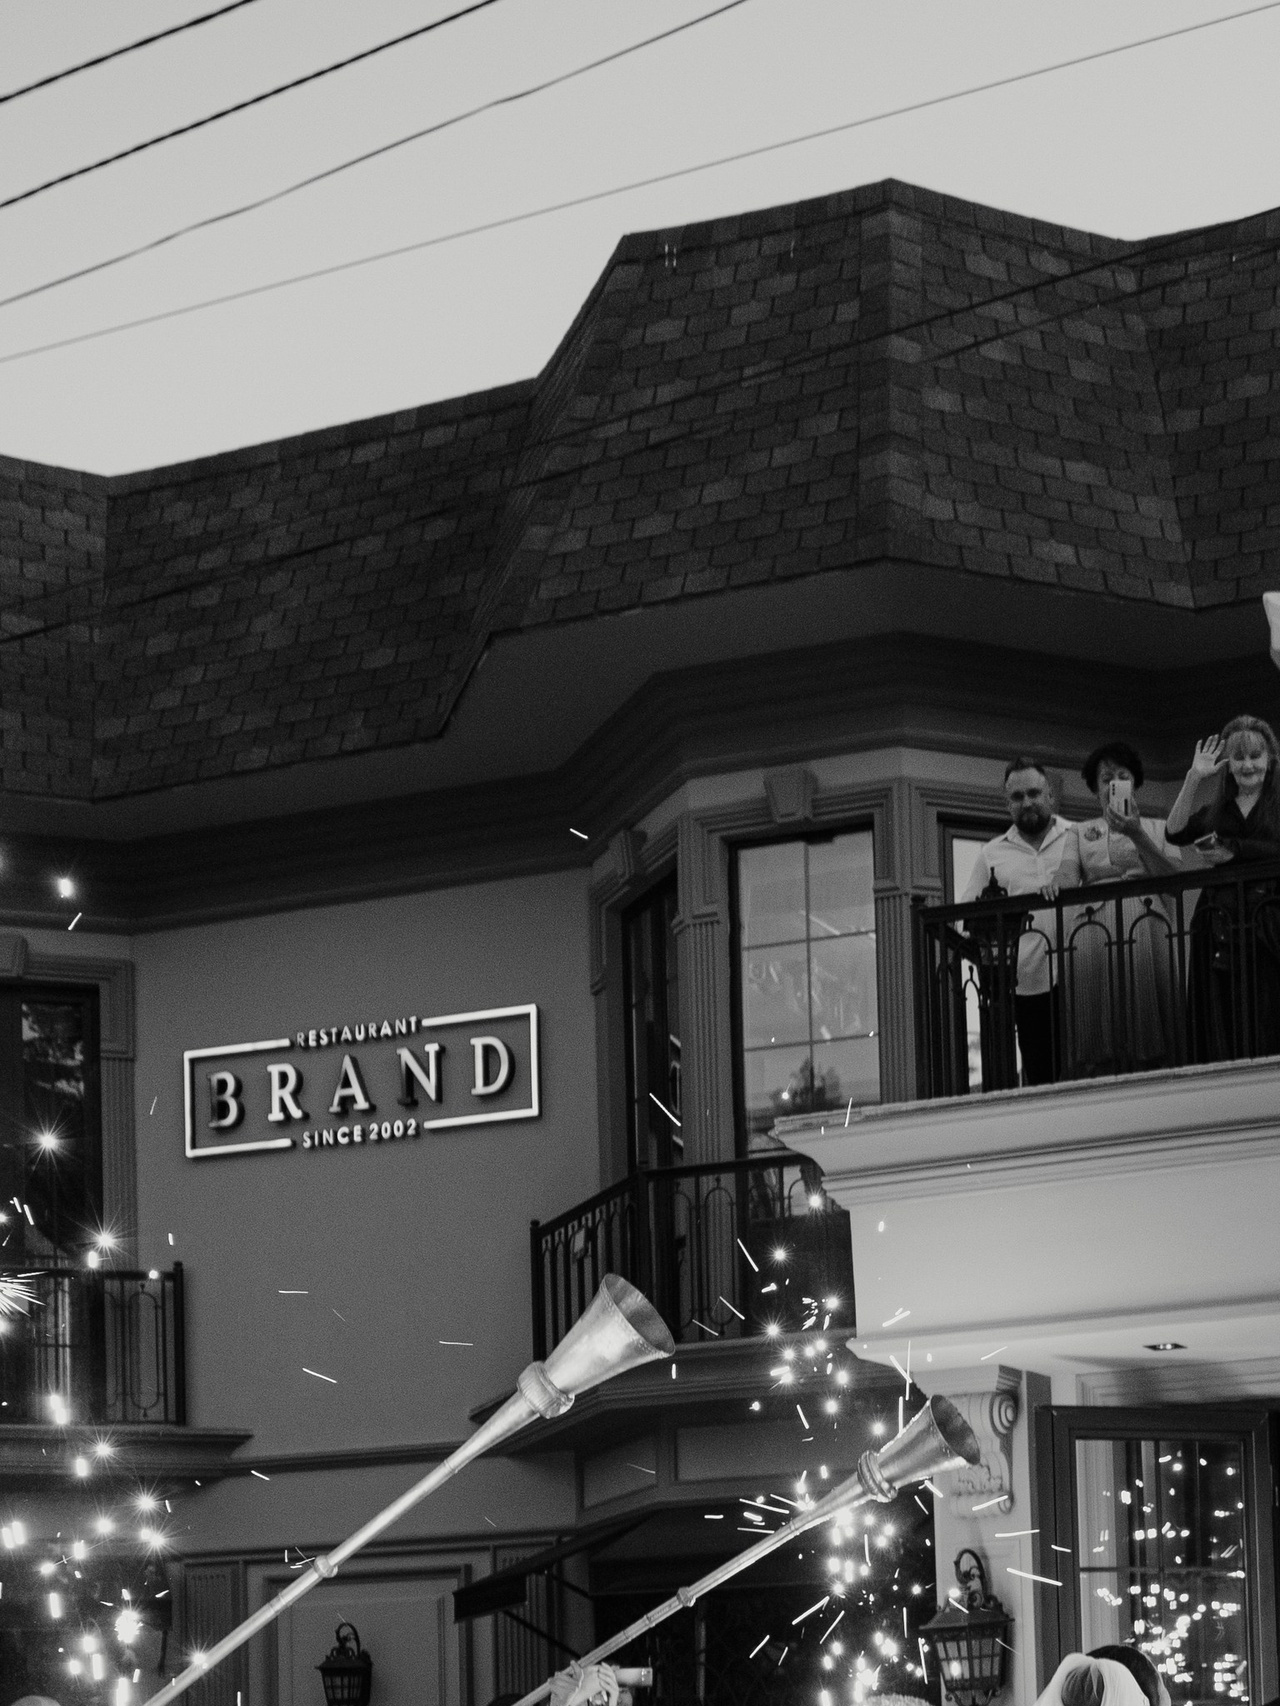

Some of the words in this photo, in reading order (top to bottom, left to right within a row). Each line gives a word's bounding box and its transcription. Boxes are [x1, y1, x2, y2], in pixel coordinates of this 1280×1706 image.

[296, 1015, 418, 1048] RESTAURANT
[208, 1035, 512, 1129] BRAND
[302, 1124, 363, 1149] SINCE
[369, 1118, 418, 1140] 2002
